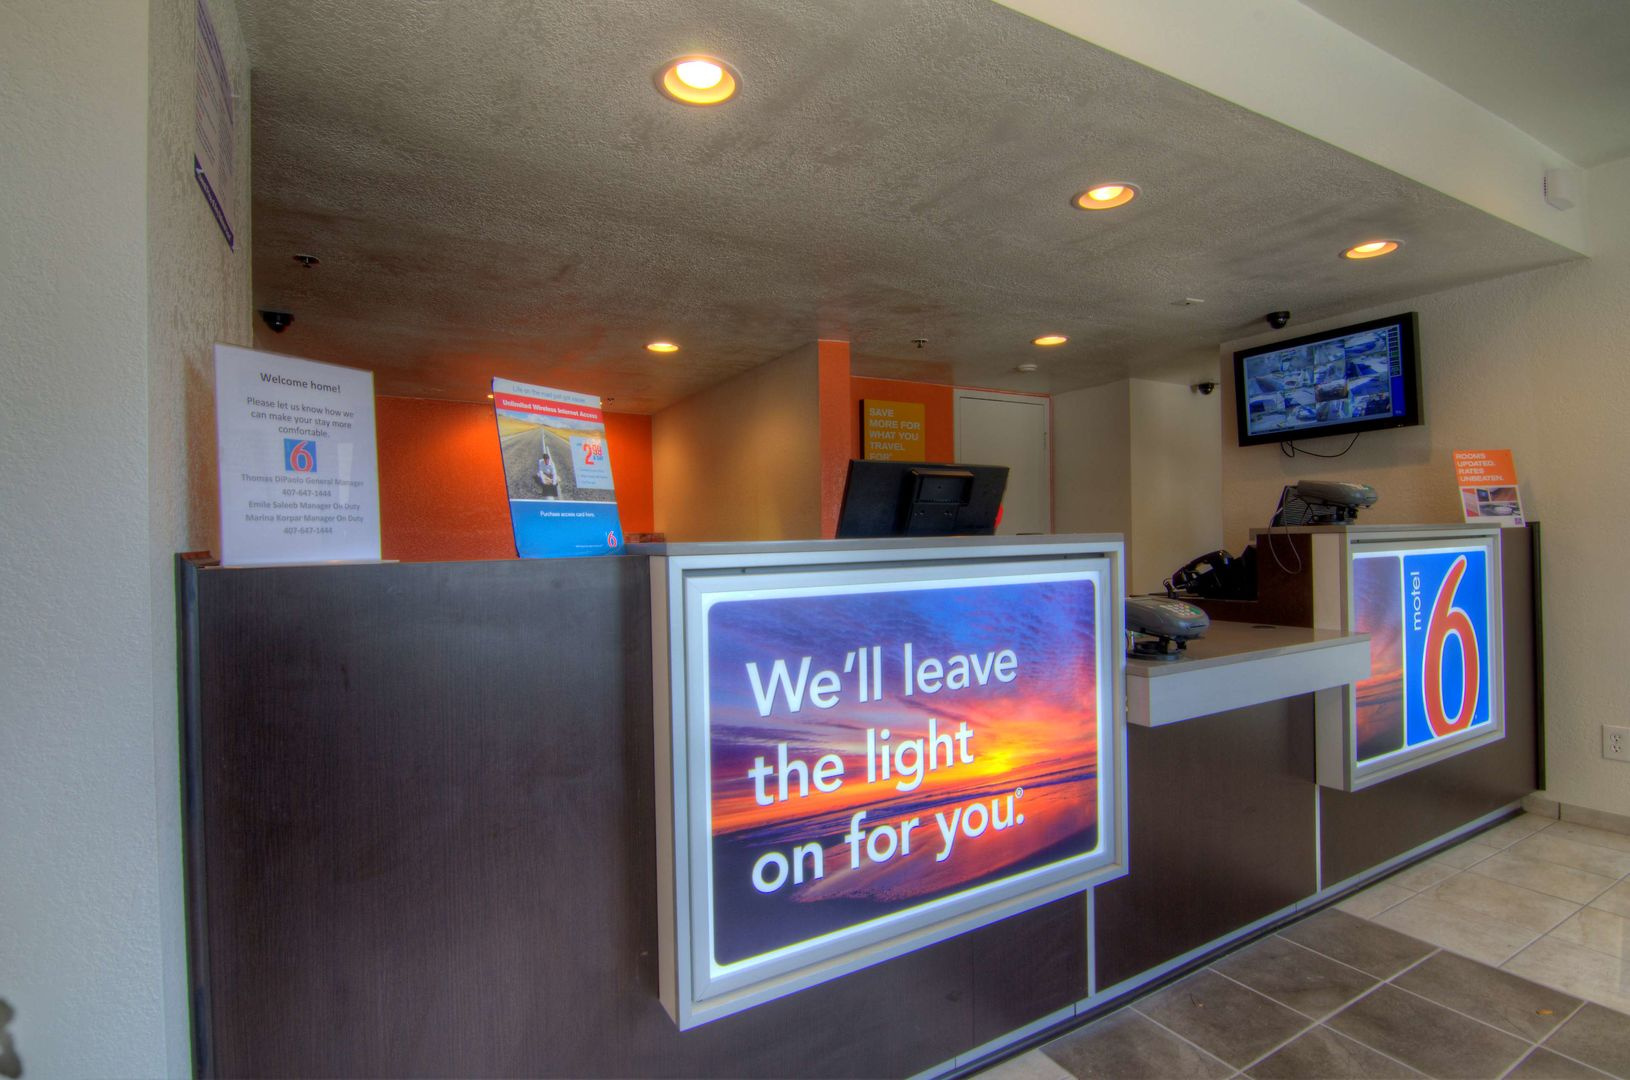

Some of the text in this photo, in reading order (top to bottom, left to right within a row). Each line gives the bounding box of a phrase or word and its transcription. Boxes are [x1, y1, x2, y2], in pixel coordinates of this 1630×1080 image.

[260, 372, 341, 393] Welcome home!
[247, 396, 276, 408] Please
[277, 400, 289, 410] let
[302, 404, 323, 414] know
[324, 407, 342, 417] how
[502, 399, 532, 409] Unlimited
[532, 404, 557, 413] Wireless
[557, 408, 579, 416] Internet
[869, 408, 894, 417] SAVE
[251, 411, 352, 429] can make your stay more
[869, 419, 920, 430] MORE FOR
[278, 425, 330, 438] comfortable.
[869, 431, 919, 441] WHAT YOU
[870, 441, 905, 451] TRAVEL
[290, 440, 314, 472] 6
[242, 474, 273, 483] Thomas
[305, 476, 333, 485] General
[335, 478, 364, 487] Manager
[300, 502, 331, 511] Manager
[332, 502, 343, 510] On
[344, 503, 360, 511] Duty
[304, 515, 335, 523] Manager
[348, 515, 364, 523] Duty
[1410, 554, 1480, 738] motel 6
[746, 642, 1018, 717] We'll leave
[748, 718, 975, 807] the light
[752, 840, 824, 893] on
[845, 811, 920, 870] for
